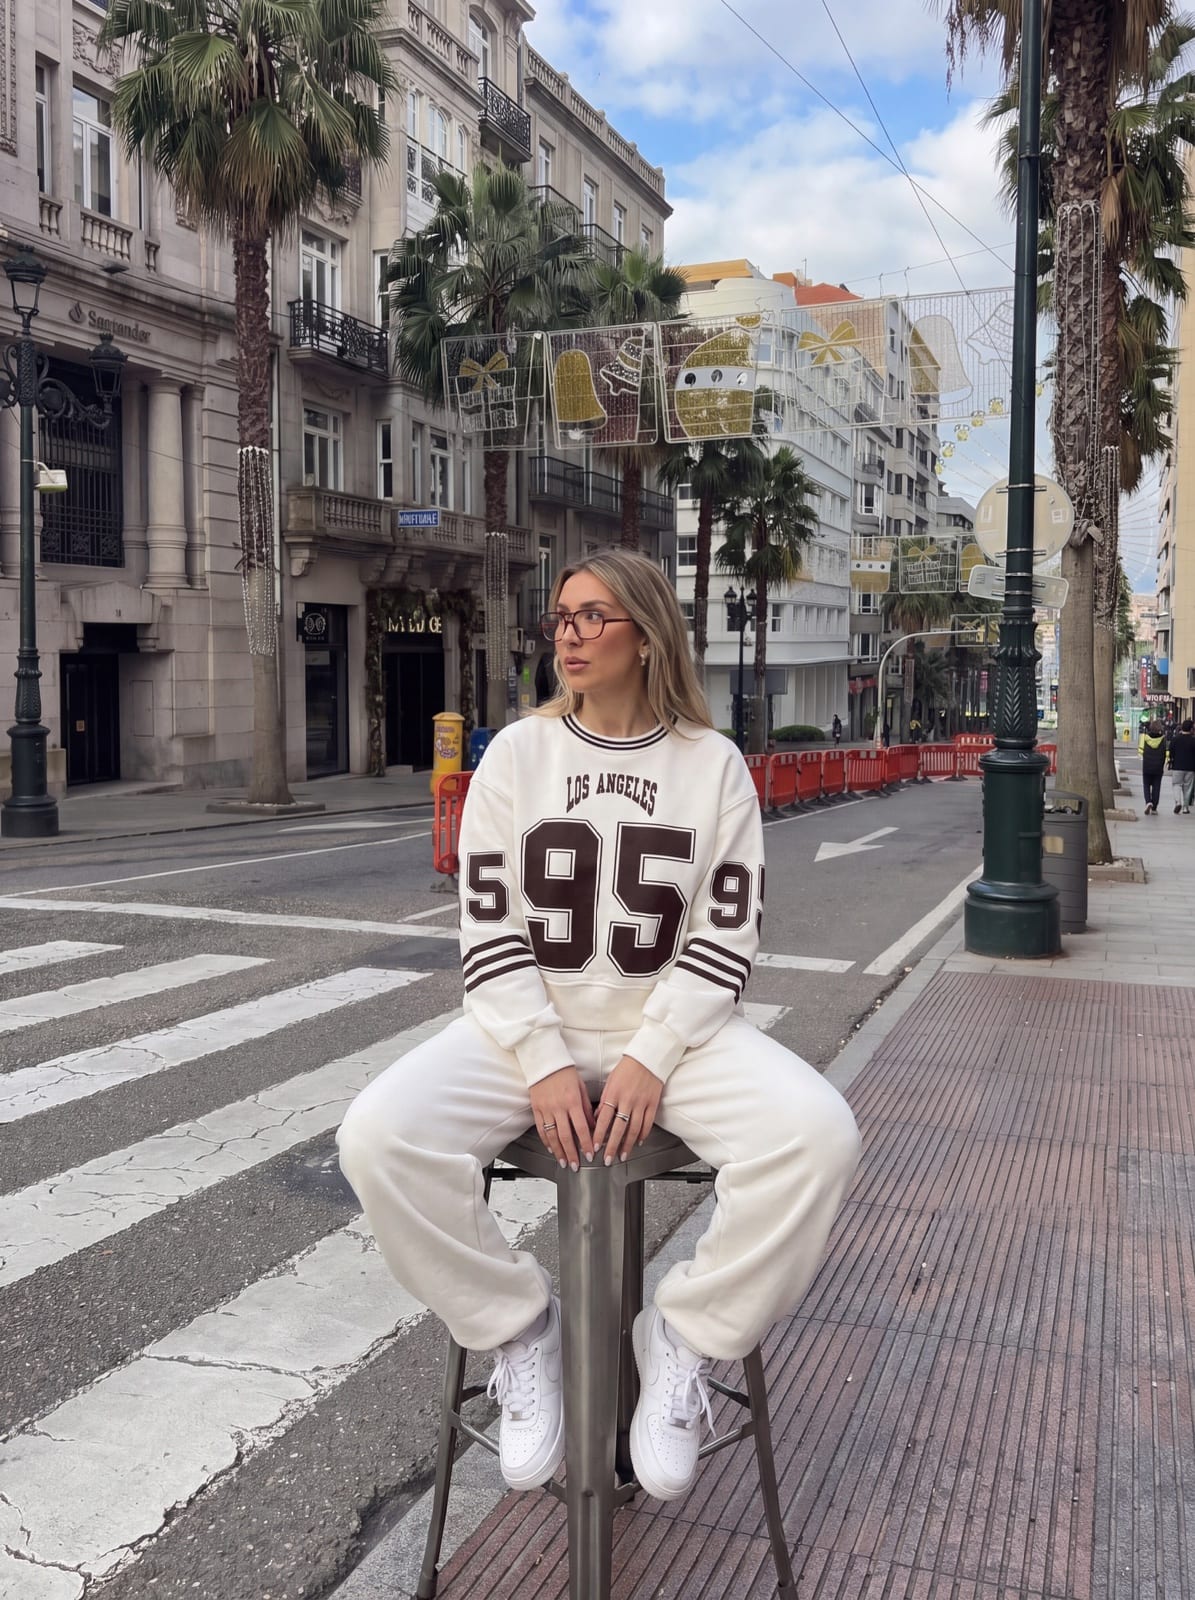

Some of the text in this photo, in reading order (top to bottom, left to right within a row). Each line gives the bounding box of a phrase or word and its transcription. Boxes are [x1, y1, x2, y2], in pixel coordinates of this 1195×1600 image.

[566, 773, 658, 817] LOS ANGELES
[520, 818, 697, 978] 95
[708, 861, 765, 940] 9
